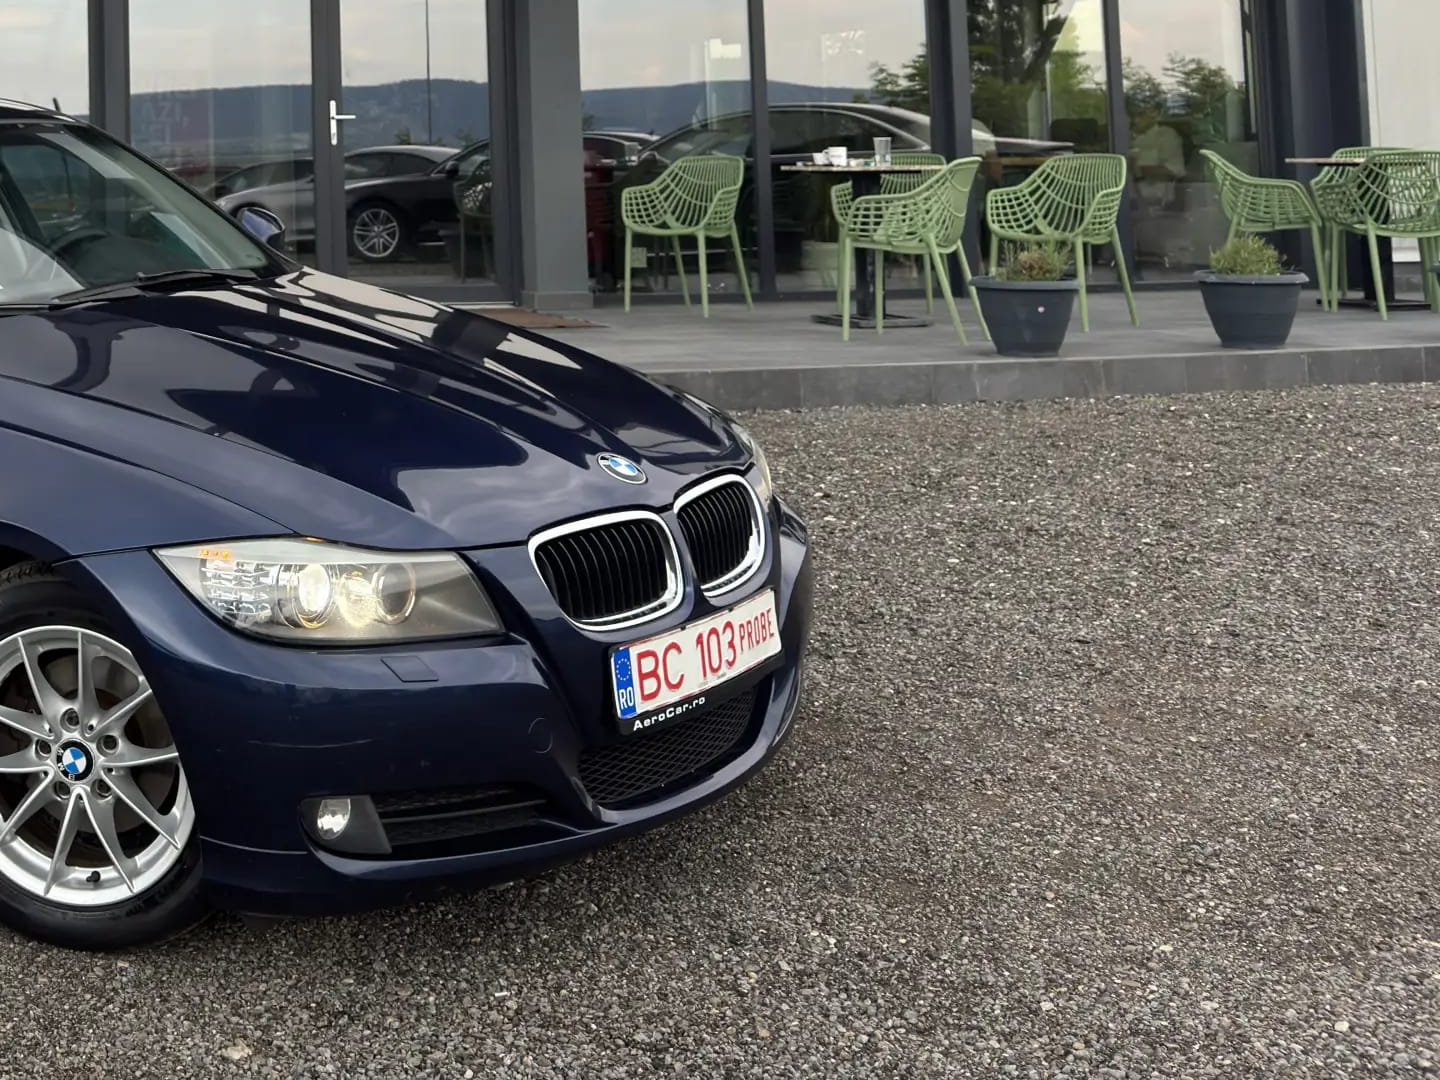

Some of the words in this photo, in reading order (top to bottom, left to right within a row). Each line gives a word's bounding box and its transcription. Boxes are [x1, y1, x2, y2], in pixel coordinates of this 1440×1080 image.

[636, 641, 685, 702] BC
[695, 620, 737, 680] 103
[738, 607, 775, 653] PROBE
[619, 686, 634, 710] RO
[632, 696, 706, 731] AeroCar.ro
